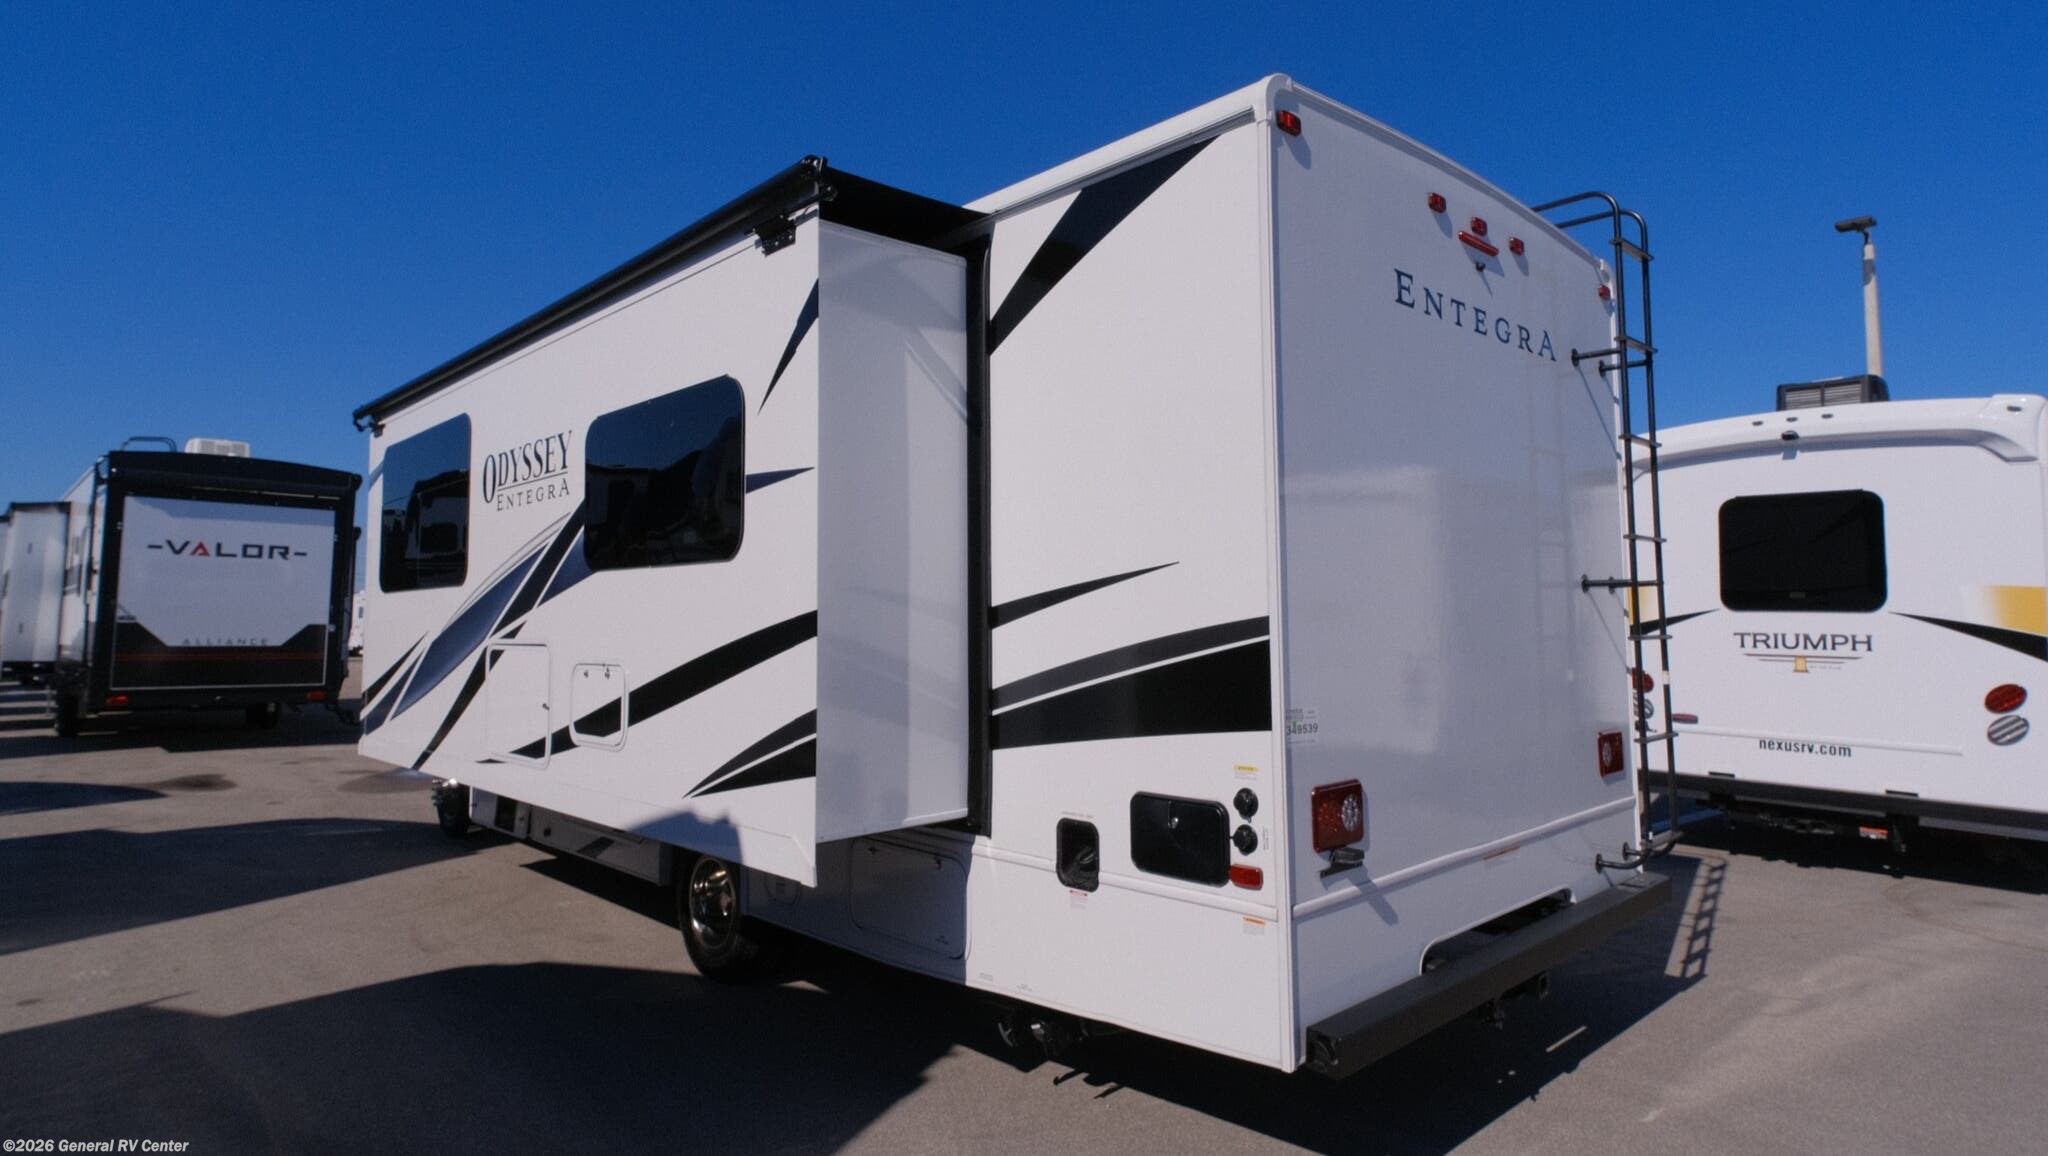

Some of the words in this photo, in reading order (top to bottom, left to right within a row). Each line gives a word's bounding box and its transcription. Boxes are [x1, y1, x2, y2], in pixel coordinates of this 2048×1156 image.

[1394, 268, 1557, 362] ENTEGRA
[482, 429, 572, 504] ODYSSEY
[497, 478, 570, 511] ENTEGRA
[182, 637, 268, 646] ALLIANCE
[1733, 632, 1872, 652] TRIUMPH
[1759, 739, 1852, 757] nexusrv.com
